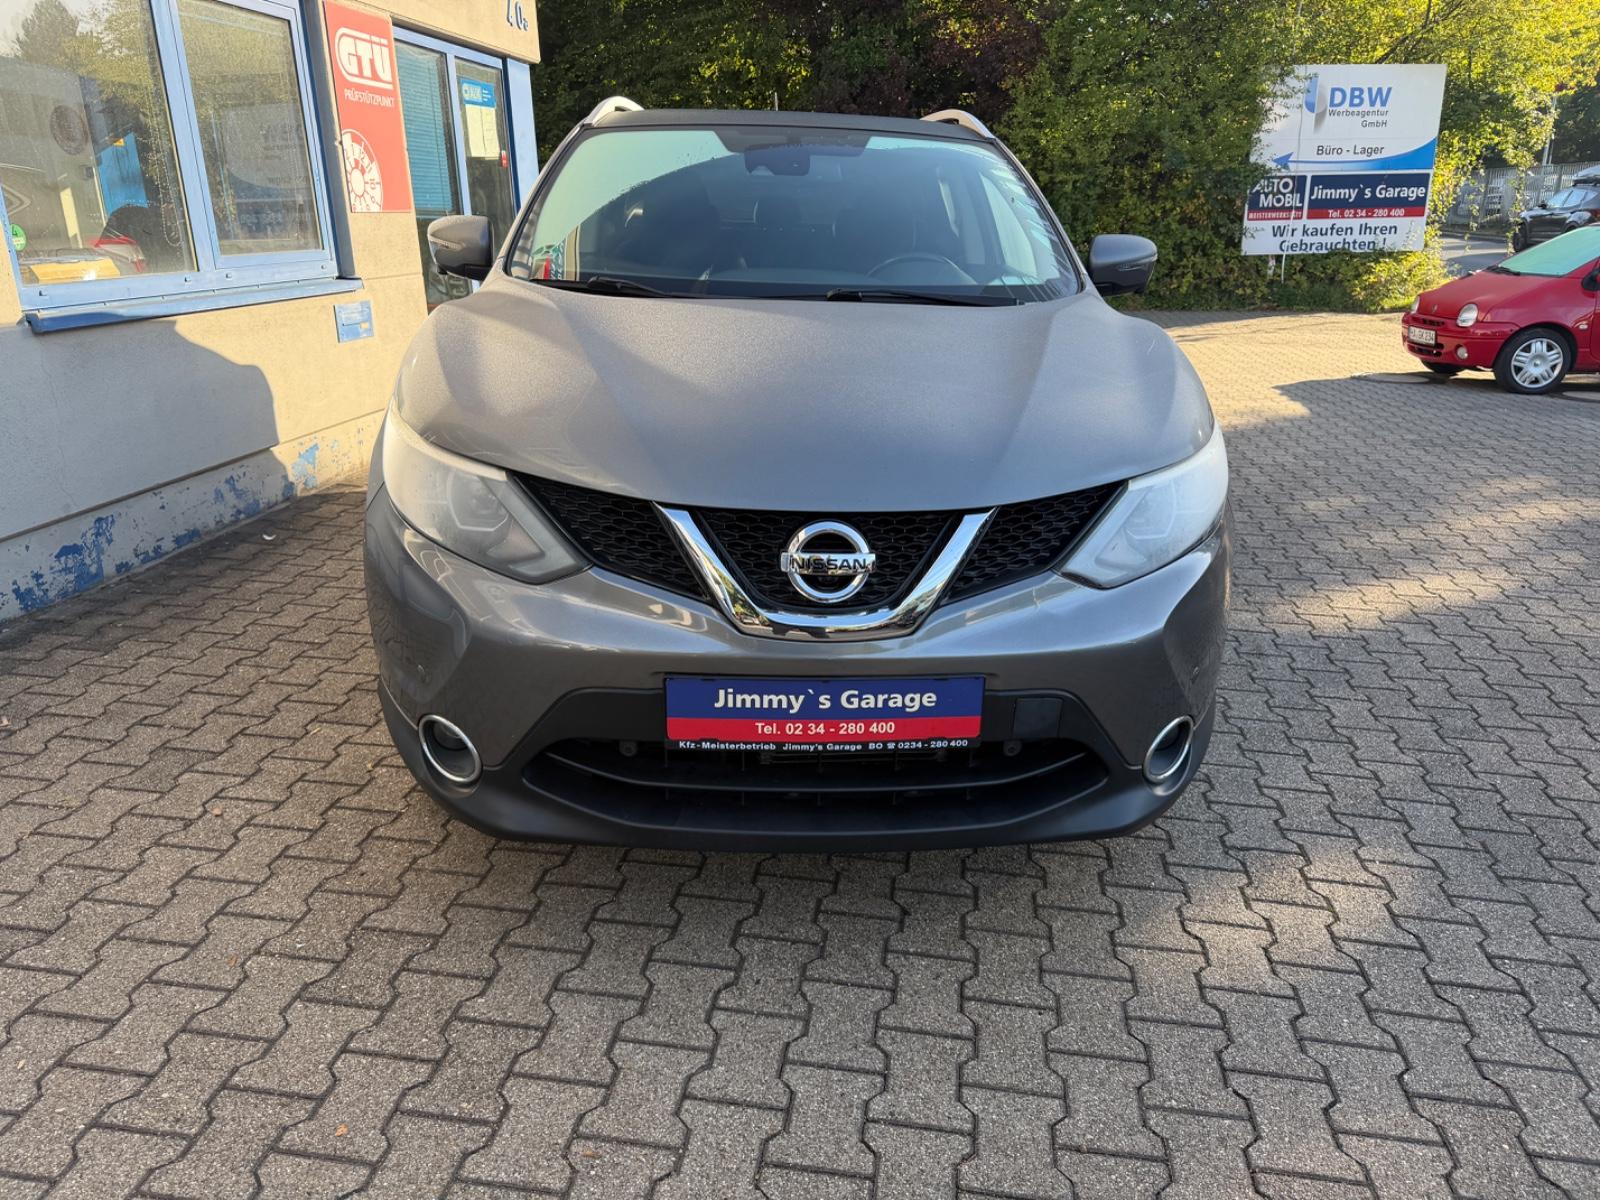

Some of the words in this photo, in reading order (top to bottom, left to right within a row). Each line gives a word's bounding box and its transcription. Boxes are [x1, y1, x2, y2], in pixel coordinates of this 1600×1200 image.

[337, 34, 393, 83] GTÜ
[1328, 87, 1392, 108] DBW
[1328, 109, 1389, 119] Werbeagentur
[1360, 120, 1388, 128] GmbH
[1316, 145, 1343, 156] Büro
[1353, 144, 1385, 158] Lager
[1375, 184, 1426, 201] Garage
[1328, 209, 1342, 218] Tel.
[1344, 209, 1354, 217] 02
[1356, 208, 1366, 217] 34
[1373, 208, 1388, 217] 280
[1389, 208, 1405, 216] 400
[1272, 223, 1298, 238] Wir
[1302, 223, 1354, 237] kaufen
[1358, 222, 1398, 236] Ihren
[1279, 238, 1376, 253] Gebrauchten
[790, 556, 867, 571] NISSAN
[840, 689, 937, 712] Garage
[754, 722, 781, 735] Tel.
[785, 723, 804, 735] 02
[807, 722, 825, 735] 34
[838, 722, 865, 735] 280
[869, 722, 896, 734] 400
[783, 743, 823, 752] Jimmy's
[827, 743, 862, 752] Garage
[868, 742, 883, 750] BO
[930, 740, 948, 748] 280
[950, 739, 968, 747] 400
